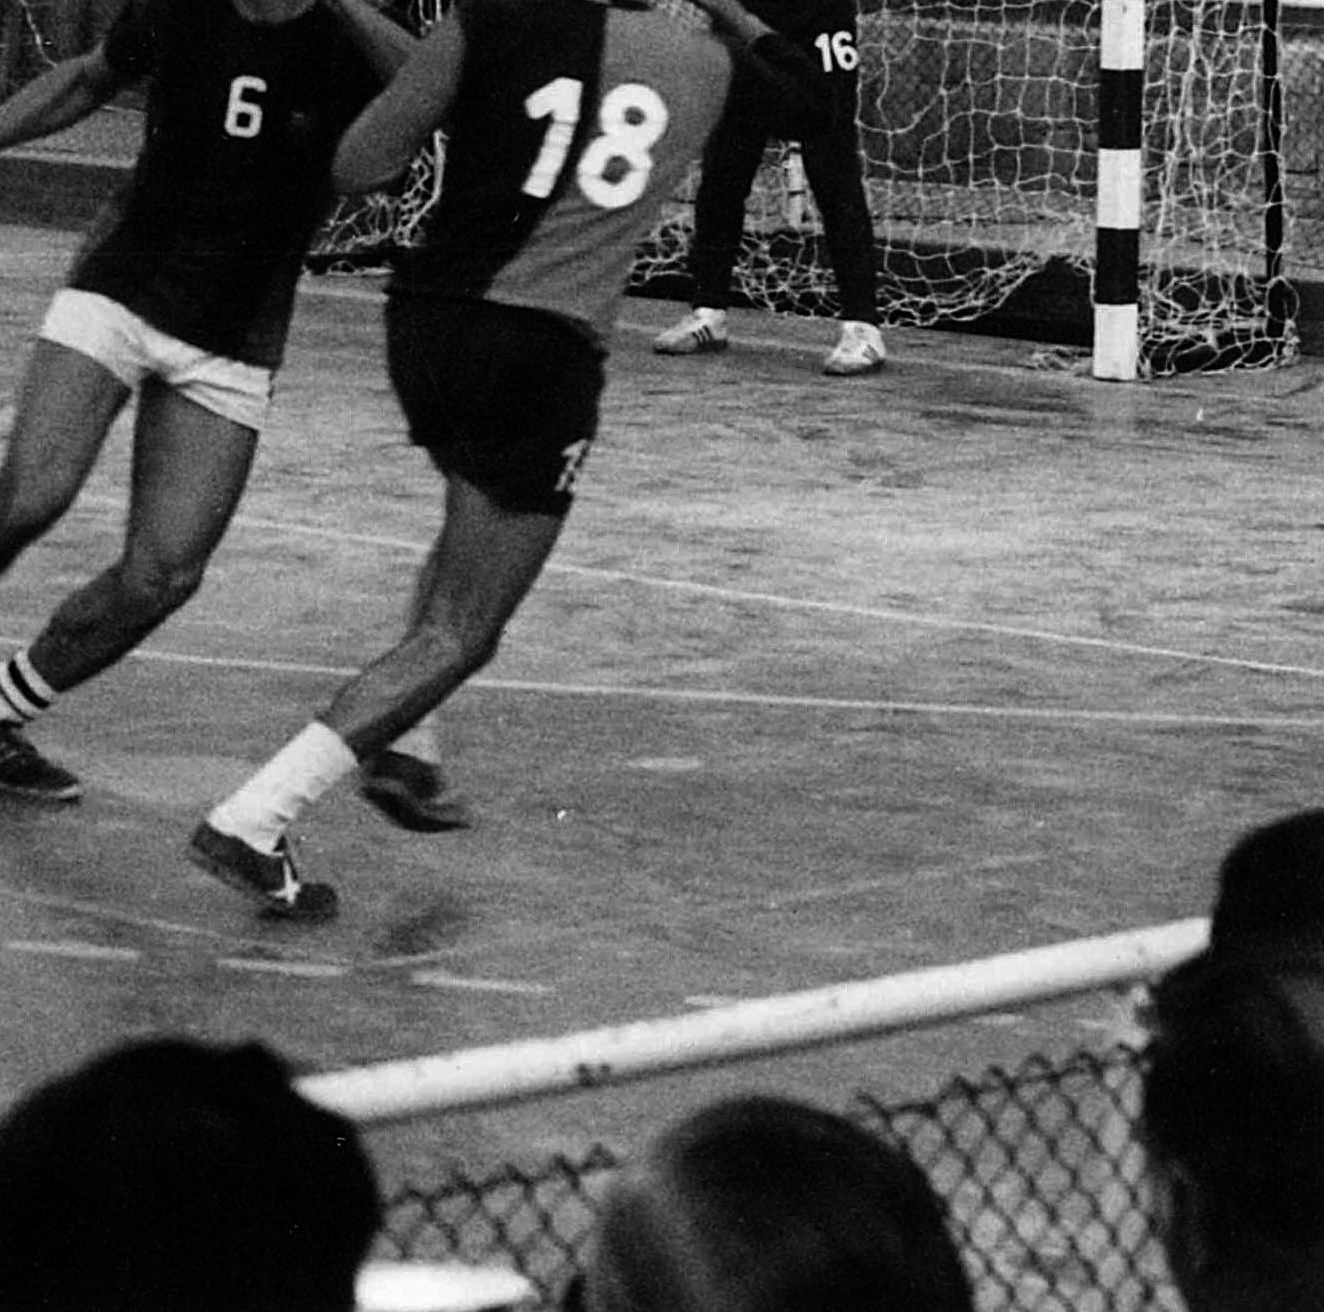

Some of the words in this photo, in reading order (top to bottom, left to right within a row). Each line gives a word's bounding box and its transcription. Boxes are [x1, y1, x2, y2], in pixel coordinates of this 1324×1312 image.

[814, 31, 859, 73] 16
[224, 75, 267, 138] 6
[522, 77, 669, 209] 18
